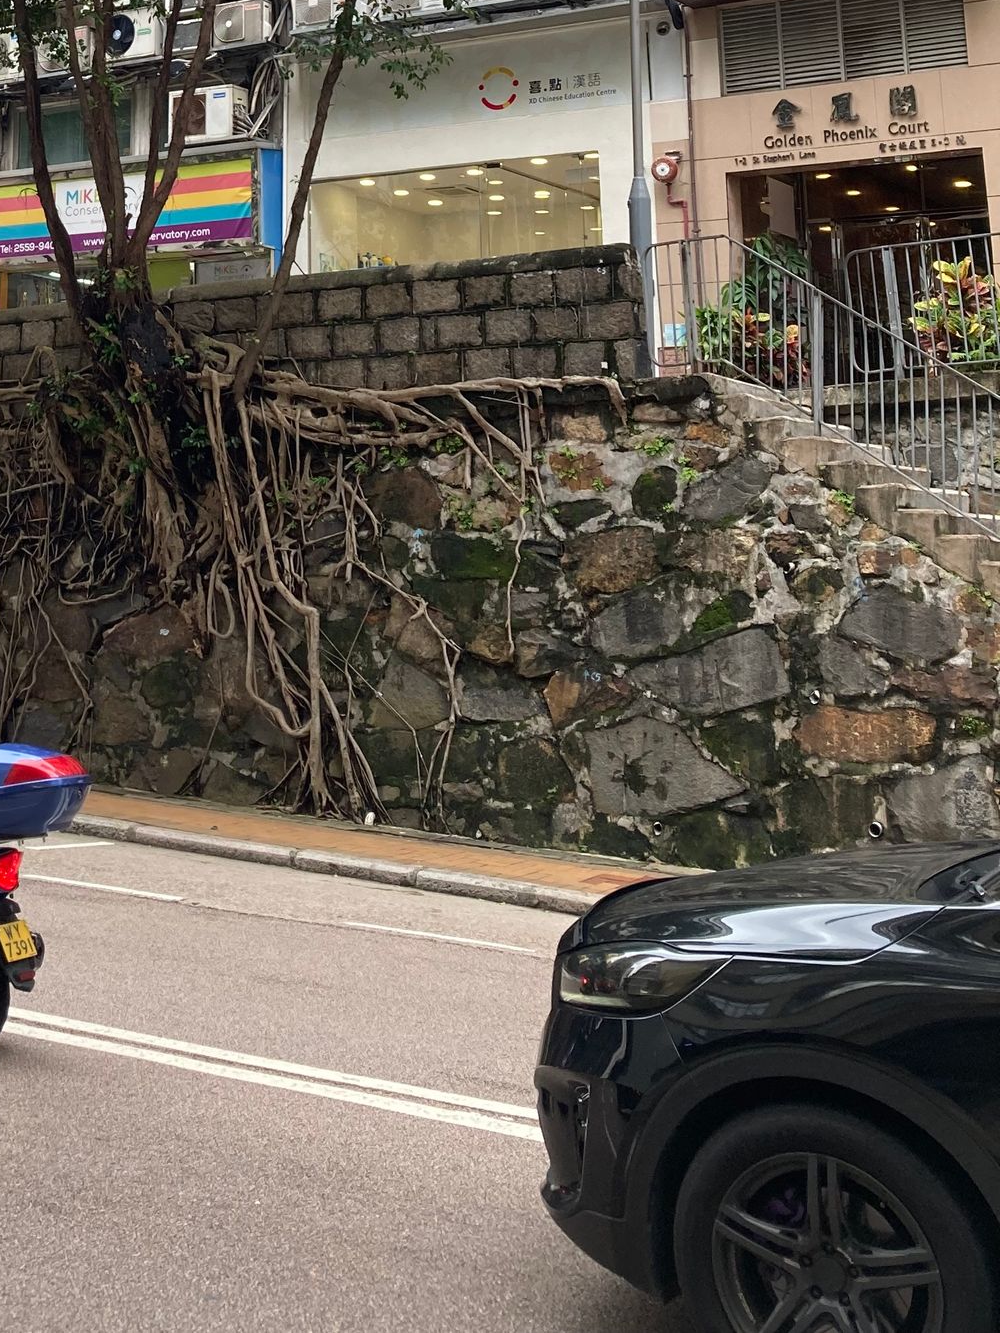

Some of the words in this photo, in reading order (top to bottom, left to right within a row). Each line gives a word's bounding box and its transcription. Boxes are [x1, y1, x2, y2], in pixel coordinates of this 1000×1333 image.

[539, 94, 563, 104] Chinese
[564, 90, 595, 100] Education
[596, 88, 617, 96] Centre
[764, 134, 813, 150] Golden
[823, 125, 878, 144] Phoenix
[888, 120, 930, 136] Court
[762, 150, 796, 164] Stephen's
[799, 149, 816, 160] Lane
[3, 923, 21, 940] WY
[5, 938, 34, 957] 7391
